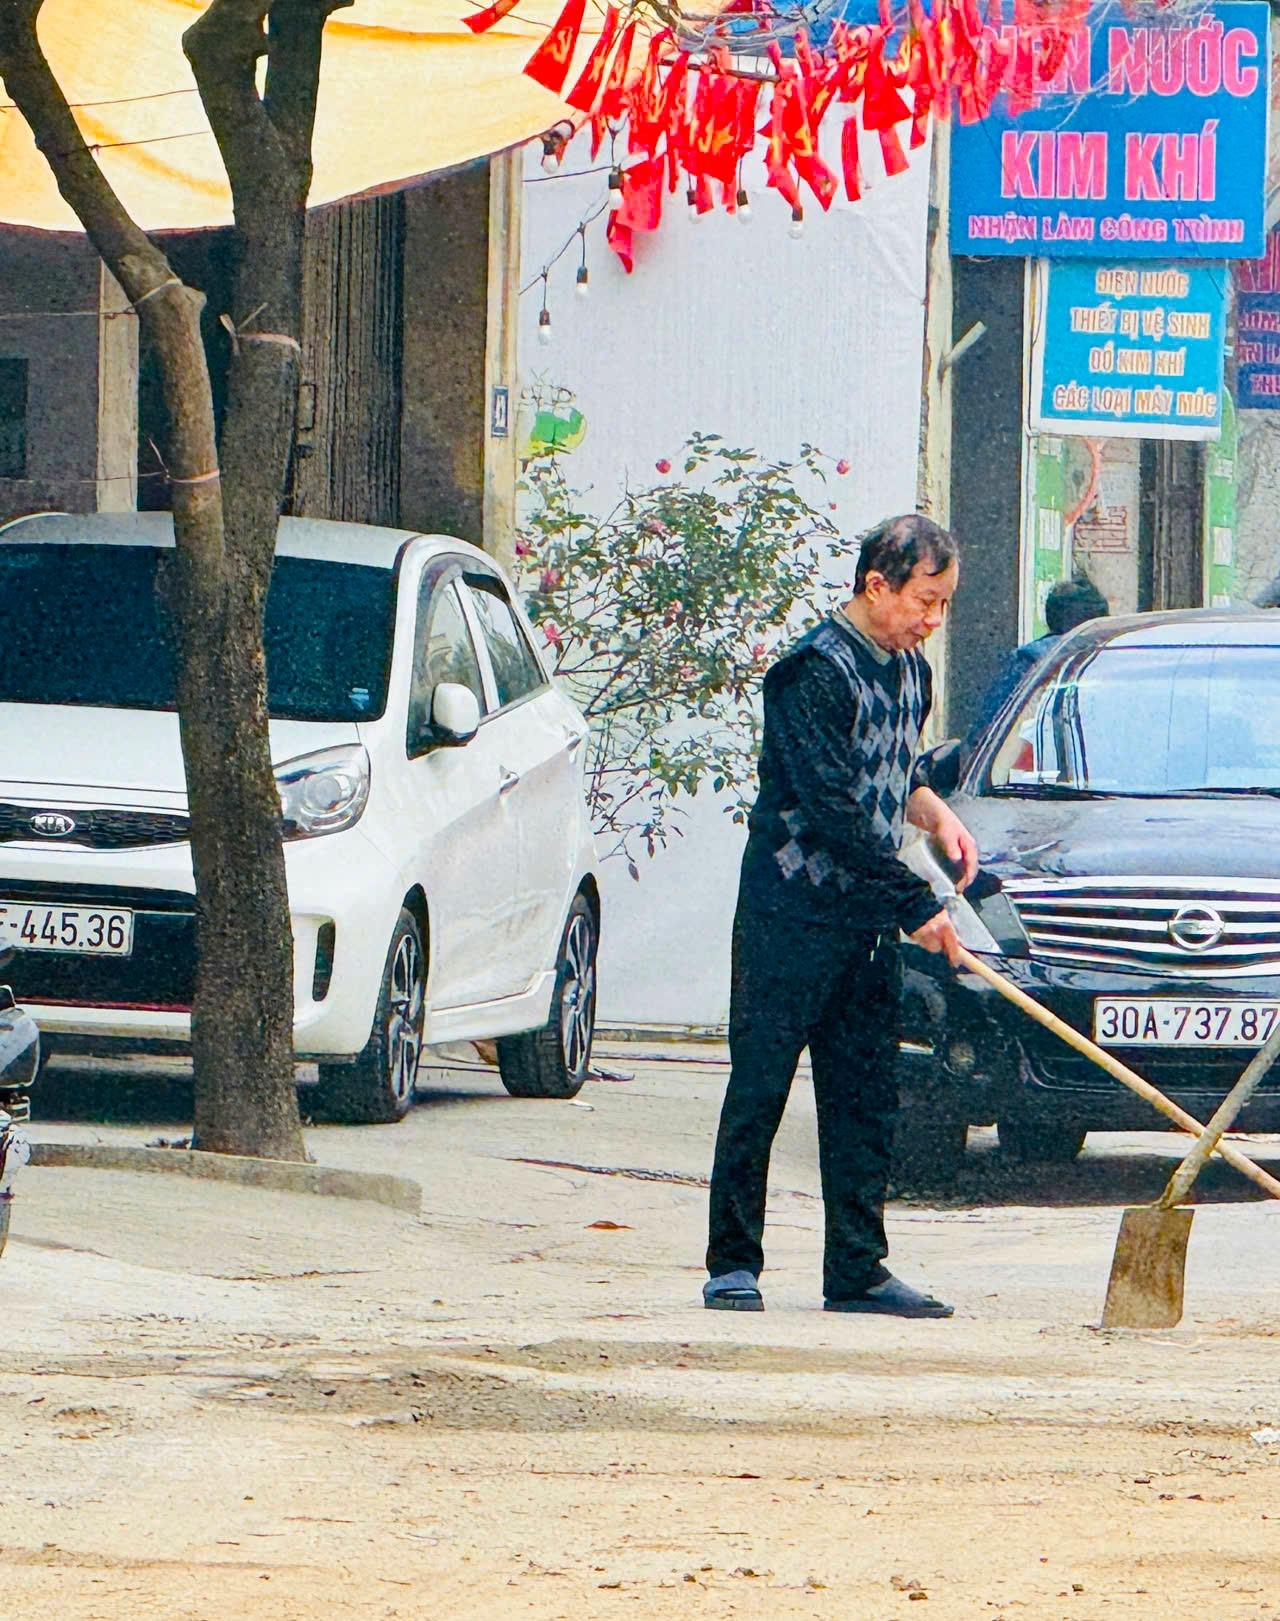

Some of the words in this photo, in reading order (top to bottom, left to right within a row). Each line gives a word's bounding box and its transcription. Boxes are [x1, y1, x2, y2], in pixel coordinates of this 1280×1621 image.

[1108, 14, 1258, 97] NƯỚC
[1001, 130, 1108, 199] KIM
[1124, 118, 1220, 201] KHÍ
[1042, 211, 1094, 241] LÀM
[1101, 213, 1167, 242] CÔNG
[1172, 214, 1244, 243] TRÌNH
[1120, 309, 1138, 340] BỊ
[1142, 307, 1164, 341] VỆ
[1167, 312, 1211, 339] SINH
[1117, 348, 1151, 374] KIM
[1154, 346, 1186, 376] KHÍ
[34, 815, 66, 832] KIA
[1101, 1006, 1279, 1041] 30A-737.87
